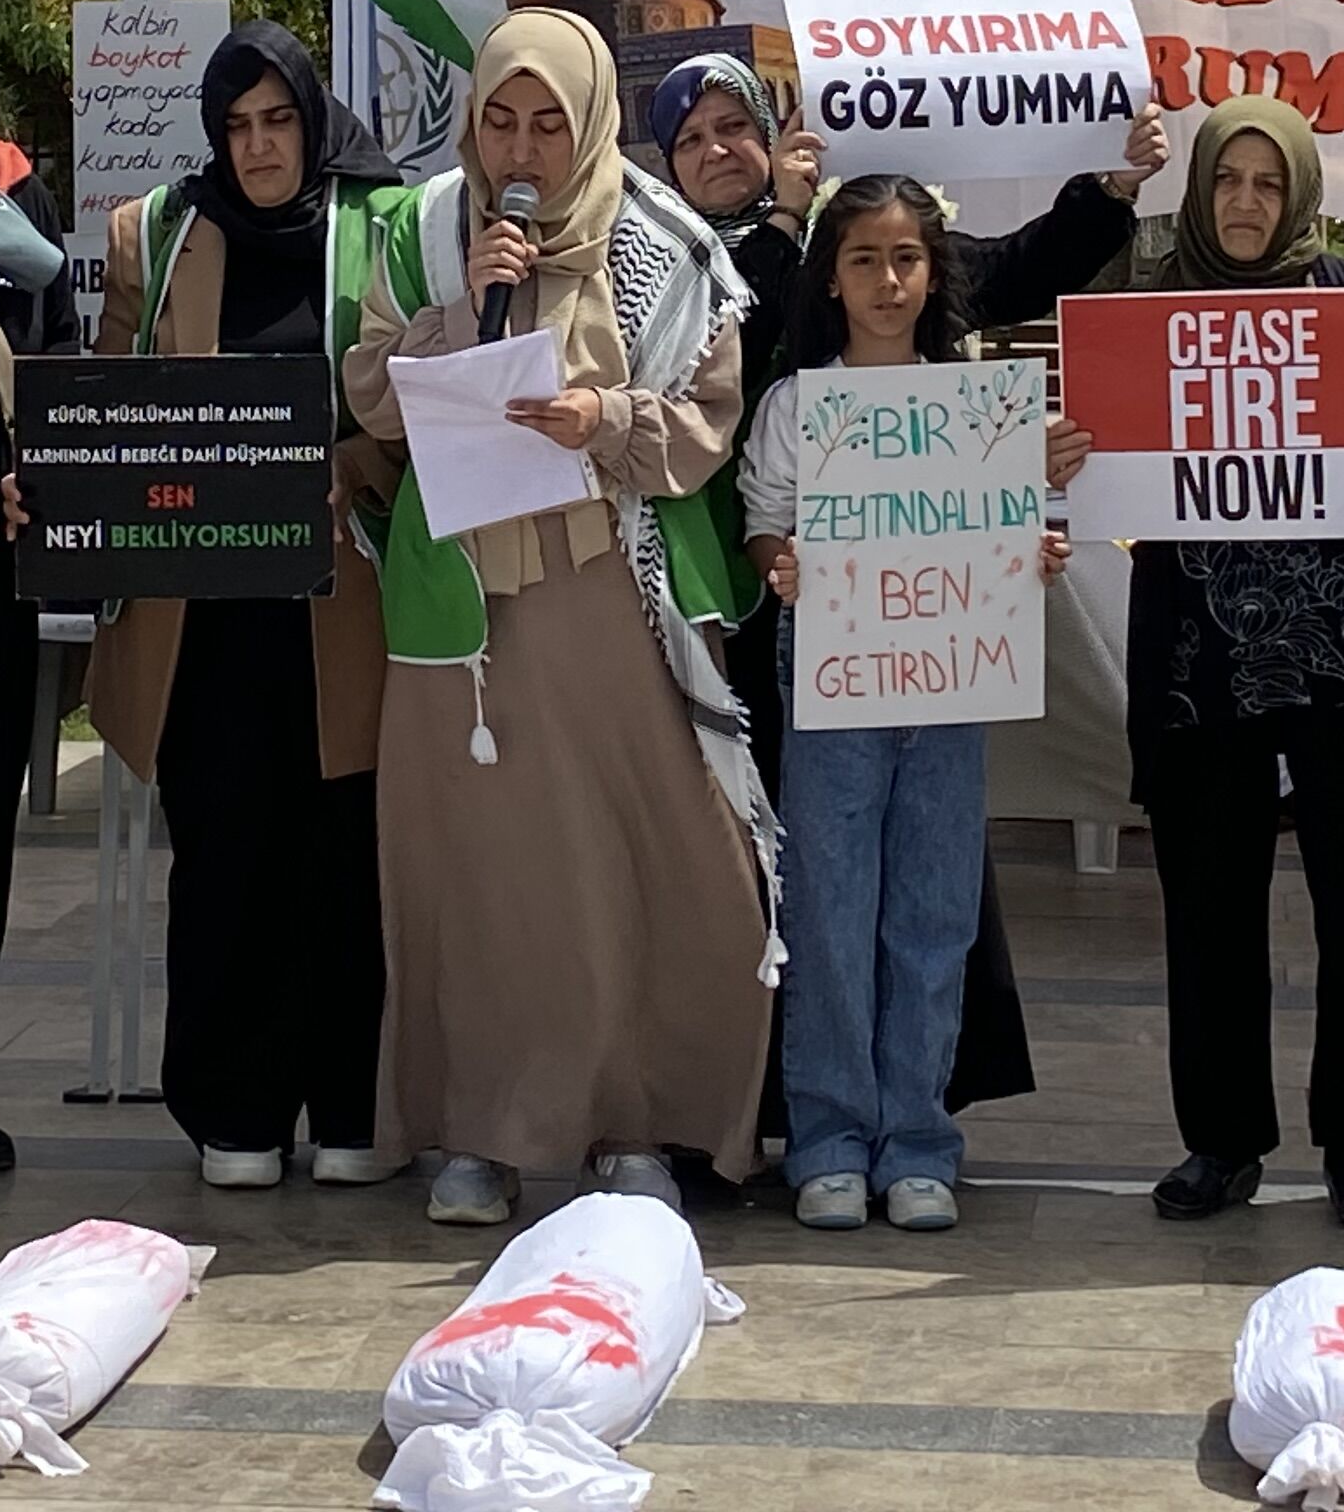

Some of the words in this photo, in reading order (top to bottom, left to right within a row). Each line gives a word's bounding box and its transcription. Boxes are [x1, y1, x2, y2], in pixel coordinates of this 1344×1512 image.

[808, 10, 1128, 59] SOYKIRIMA
[820, 65, 929, 132] GÖZ
[939, 69, 1134, 128] YUMMA
[1168, 308, 1320, 367] CEASE
[105, 403, 194, 422] MÜSLÜMAN
[198, 403, 224, 422] BİR
[228, 406, 292, 422] ANANIN
[873, 395, 957, 460] BİR
[1170, 366, 1322, 450] FIRE
[22, 444, 116, 464] KARNINDAKİ
[121, 445, 177, 464] BEBEĞE
[182, 444, 221, 462] DAHİ
[225, 444, 325, 466] DÜŞMANKEN
[147, 485, 195, 508] SEN
[1173, 454, 1326, 521] NOW!
[46, 519, 102, 549] NEYİ
[111, 519, 311, 548] BEKLİYORSUN?!
[880, 561, 971, 620] BEN
[816, 634, 1018, 699] GETİRDİM
